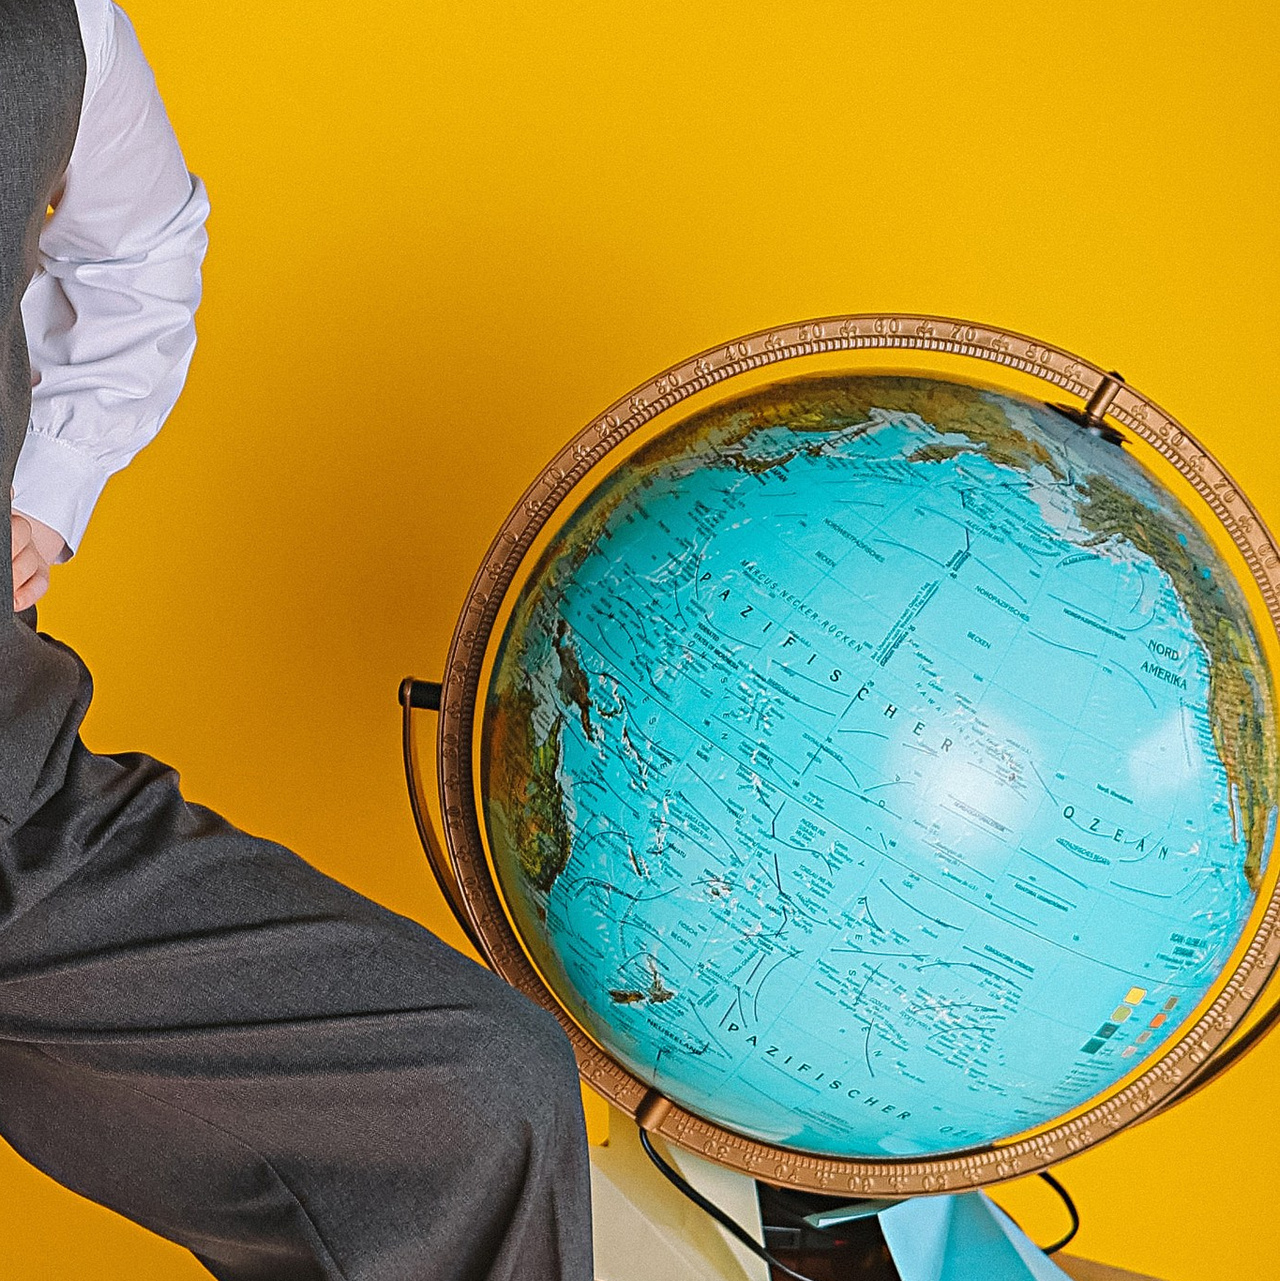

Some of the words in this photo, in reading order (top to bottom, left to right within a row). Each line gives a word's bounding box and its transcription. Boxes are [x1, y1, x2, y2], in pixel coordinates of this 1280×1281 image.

[699, 571, 954, 754] PAZIFISCHER
[1140, 660, 1188, 691] AMERIKA
[1147, 638, 1180, 662] NORD
[1063, 805, 1169, 860] OZEAN
[727, 1022, 912, 1120] PAZIFISCHER
